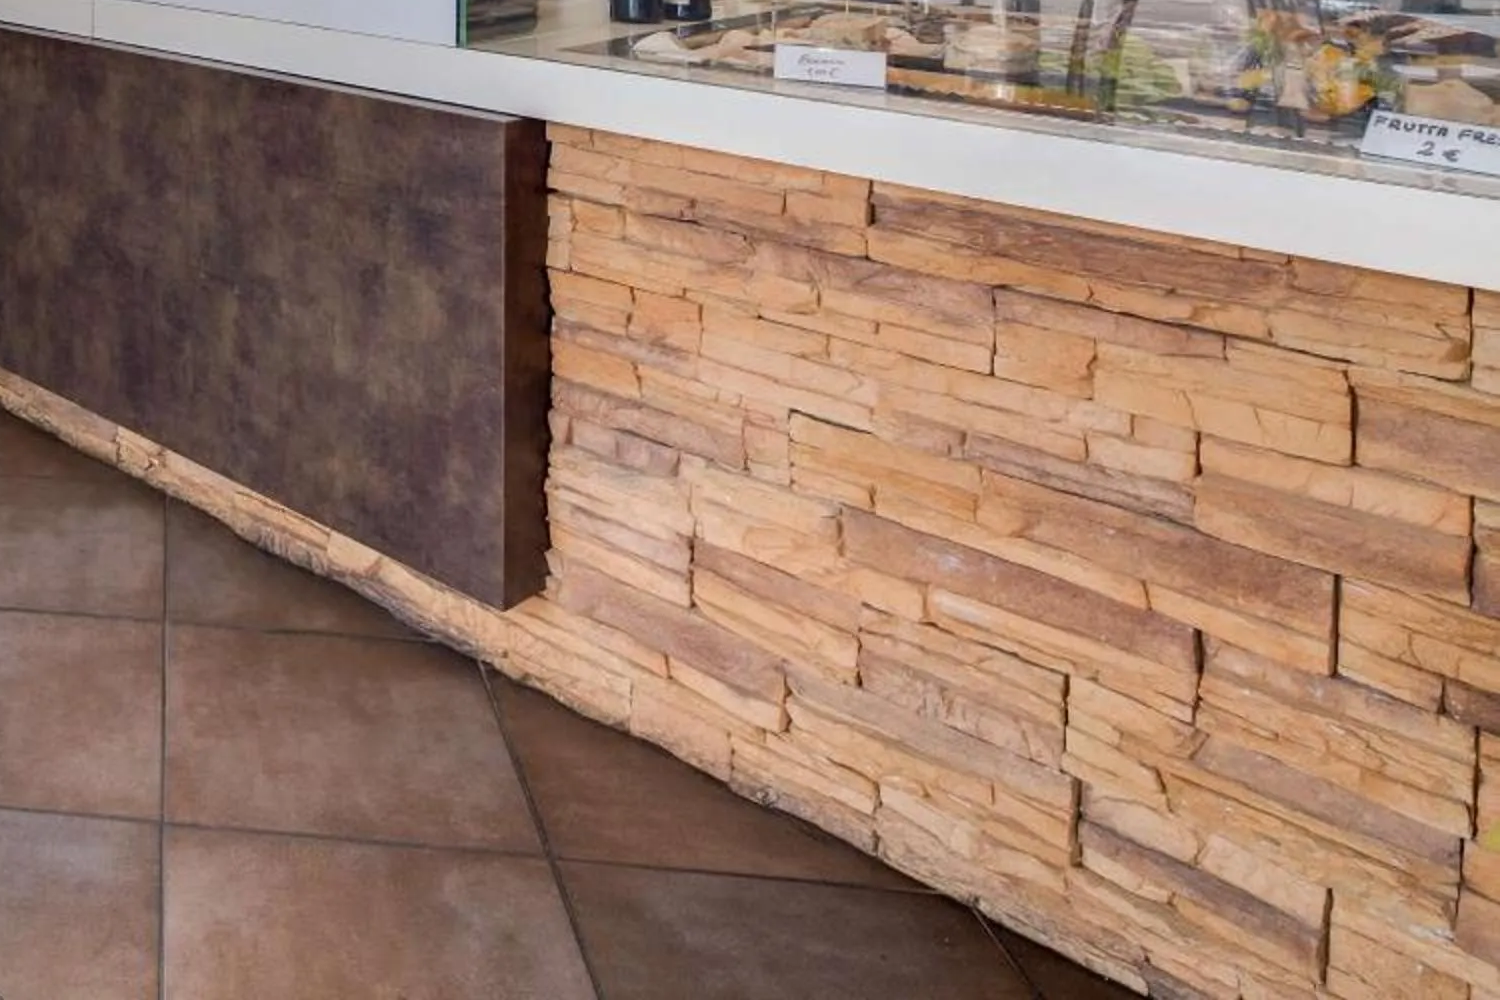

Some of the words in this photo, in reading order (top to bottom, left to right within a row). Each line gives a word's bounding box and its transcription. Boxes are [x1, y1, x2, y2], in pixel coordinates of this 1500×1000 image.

[1373, 115, 1449, 137] FRUTTA
[1457, 129, 1500, 147] FRE
[1416, 141, 1435, 157] 2
[1442, 149, 1461, 162] €
